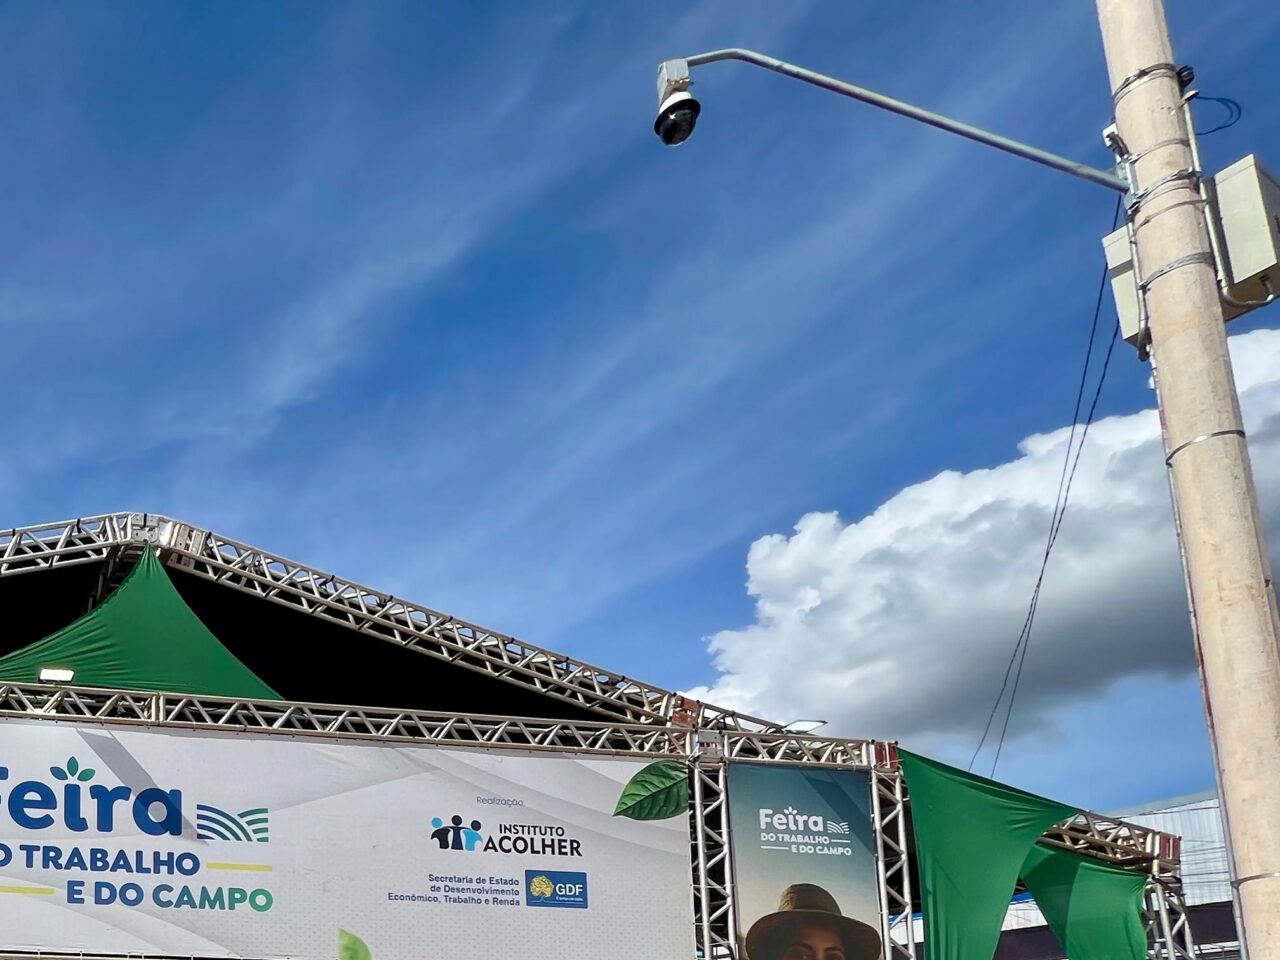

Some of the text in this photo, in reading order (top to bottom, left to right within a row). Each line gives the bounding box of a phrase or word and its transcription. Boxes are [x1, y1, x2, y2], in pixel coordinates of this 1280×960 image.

[476, 796, 524, 808] Realização
[759, 806, 824, 832] Feira
[499, 823, 565, 837] INSTITUTO
[760, 833, 829, 844] DO TRABALHO
[483, 835, 583, 857] ACOLHER
[791, 845, 852, 856] E DO CAMPO
[19, 844, 200, 876] TRABALHO
[428, 874, 520, 886] Secretaria de Estado
[430, 885, 520, 896] de Desenvolvimento
[555, 883, 583, 896] GDF
[66, 880, 274, 912] E DO CAMPO
[444, 895, 483, 905] Trabalho
[492, 897, 520, 906] Renda
